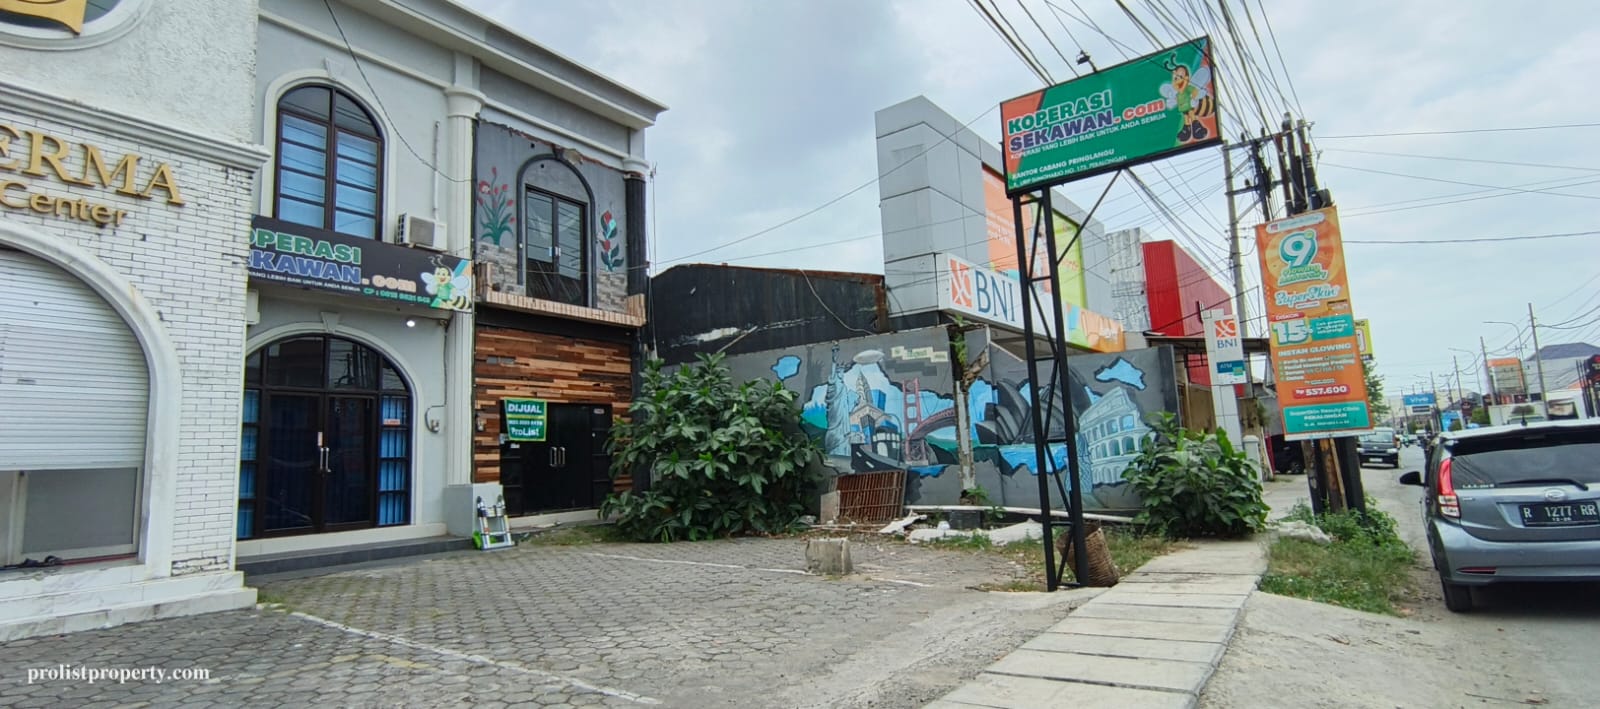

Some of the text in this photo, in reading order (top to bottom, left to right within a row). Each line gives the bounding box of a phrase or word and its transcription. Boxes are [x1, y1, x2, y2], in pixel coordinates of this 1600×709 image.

[1008, 89, 1113, 135] KOPERASI
[1010, 112, 1166, 160] KOPERASI YANG LEBIH BAIK UNTUK ANDA SEMUA
[1039, 160, 1067, 173] CABANG
[0, 180, 128, 227] Center
[975, 269, 1017, 323] BNI
[1216, 338, 1238, 349] BNI
[1310, 343, 1352, 353] GLOWING
[508, 403, 543, 413] DIJUAL
[1523, 504, 1597, 518] R 1277 RR
